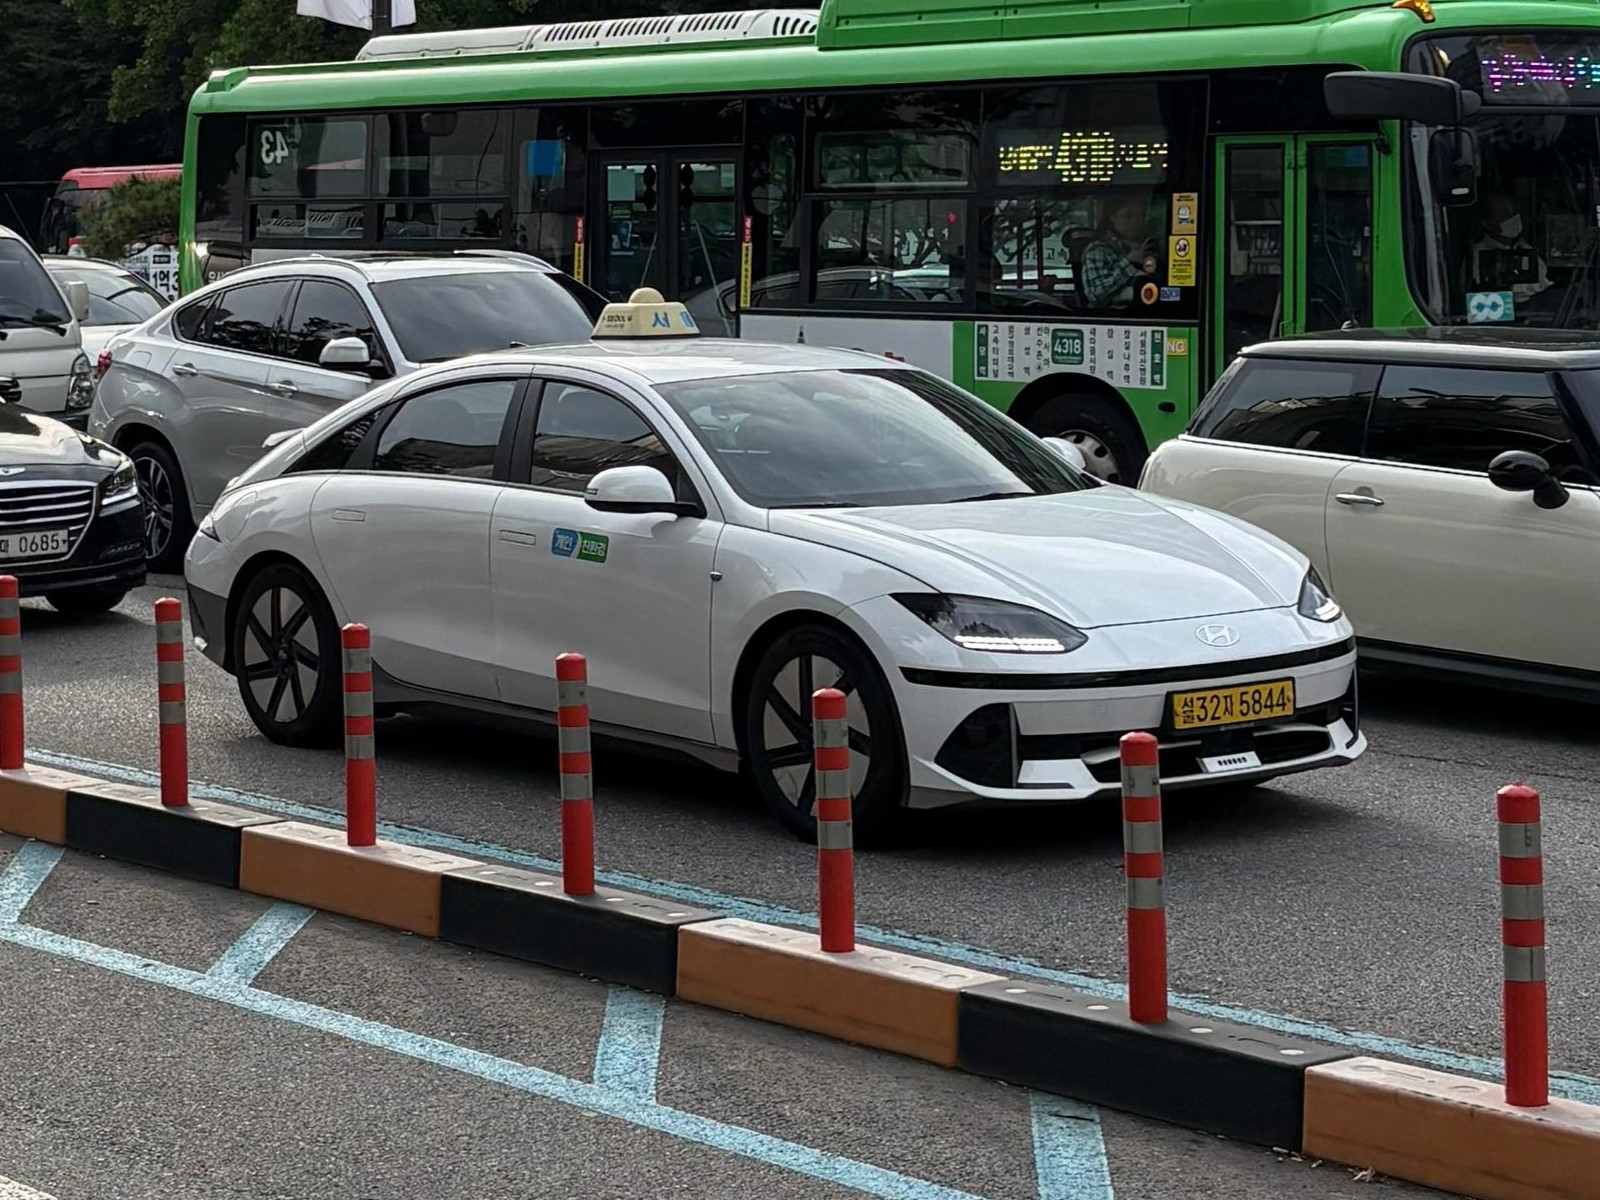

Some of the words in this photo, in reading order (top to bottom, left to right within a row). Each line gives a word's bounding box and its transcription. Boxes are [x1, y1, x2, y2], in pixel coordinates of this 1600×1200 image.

[1054, 339, 1082, 355] 4318
[1167, 340, 1185, 352] NG
[19, 532, 60, 553] 0685
[1182, 696, 1195, 725] 서울
[1239, 686, 1288, 717] 5844
